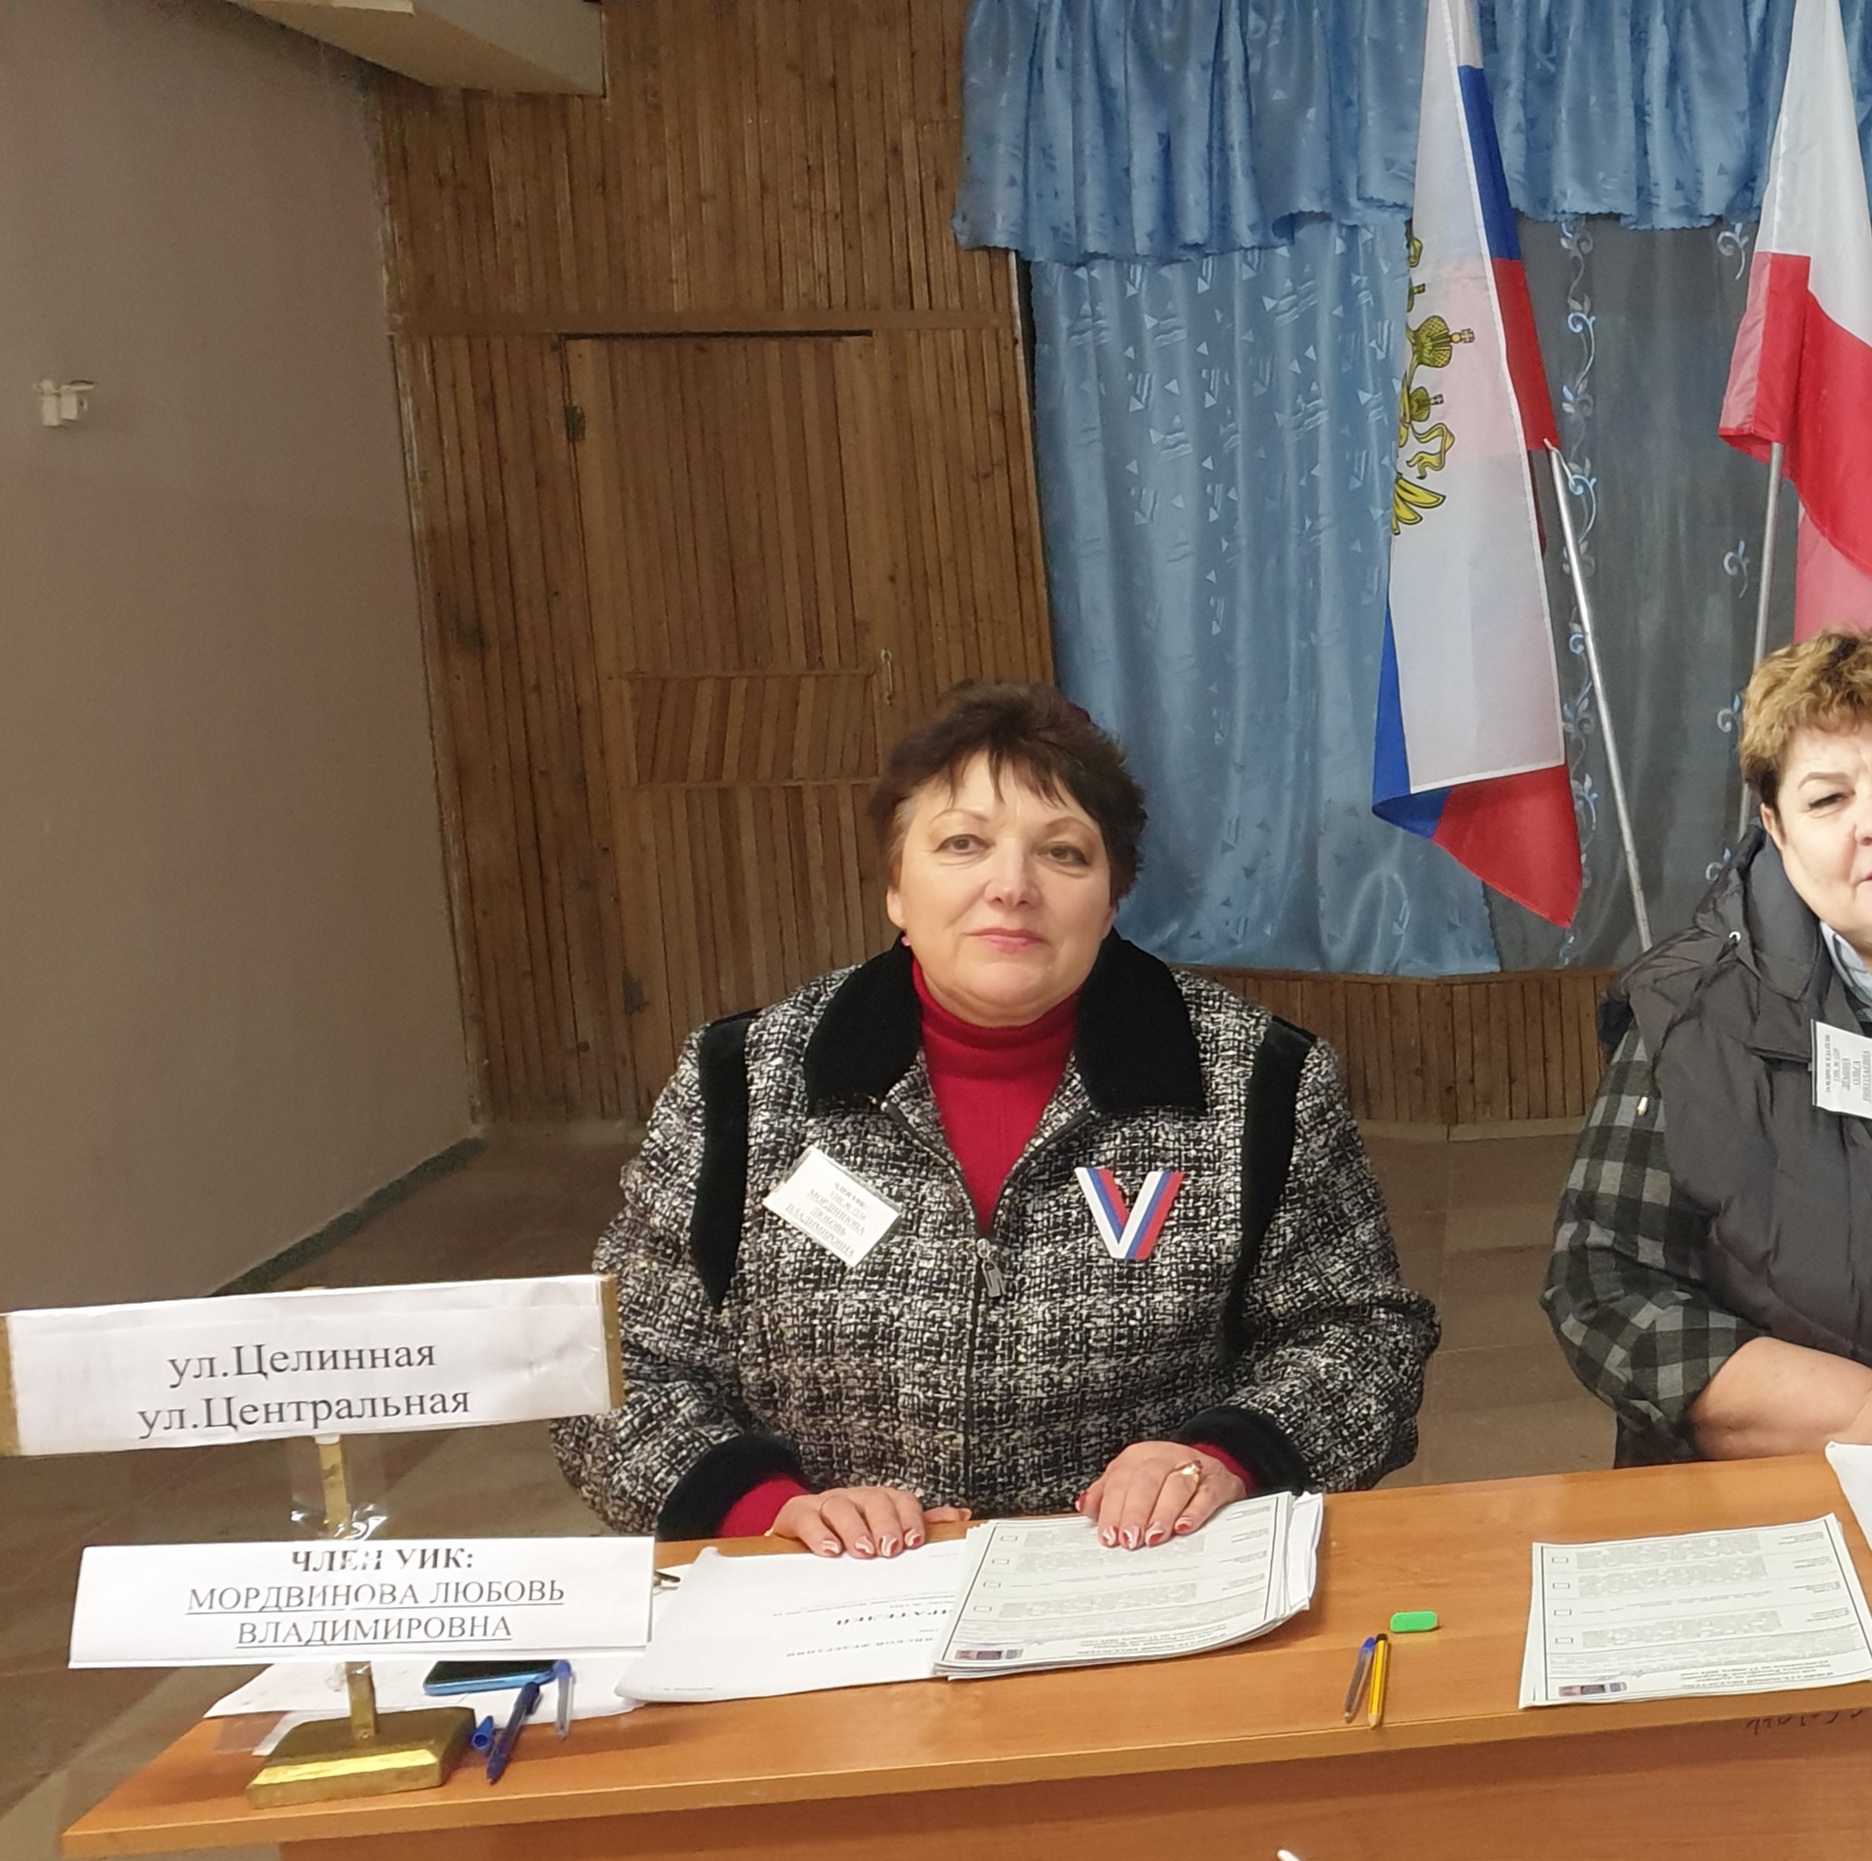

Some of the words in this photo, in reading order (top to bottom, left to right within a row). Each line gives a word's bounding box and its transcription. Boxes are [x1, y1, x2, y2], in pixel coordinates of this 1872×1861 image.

[167, 1342, 436, 1387] ул.Целинная
[137, 1391, 470, 1439] ул.Центральная
[396, 1547, 474, 1570] УИК:
[186, 1584, 420, 1613] МОРДВИНОВА
[429, 1580, 565, 1604] ЛЮБОВЬ
[237, 1615, 512, 1647] ВЛАДИМИРОВНА
